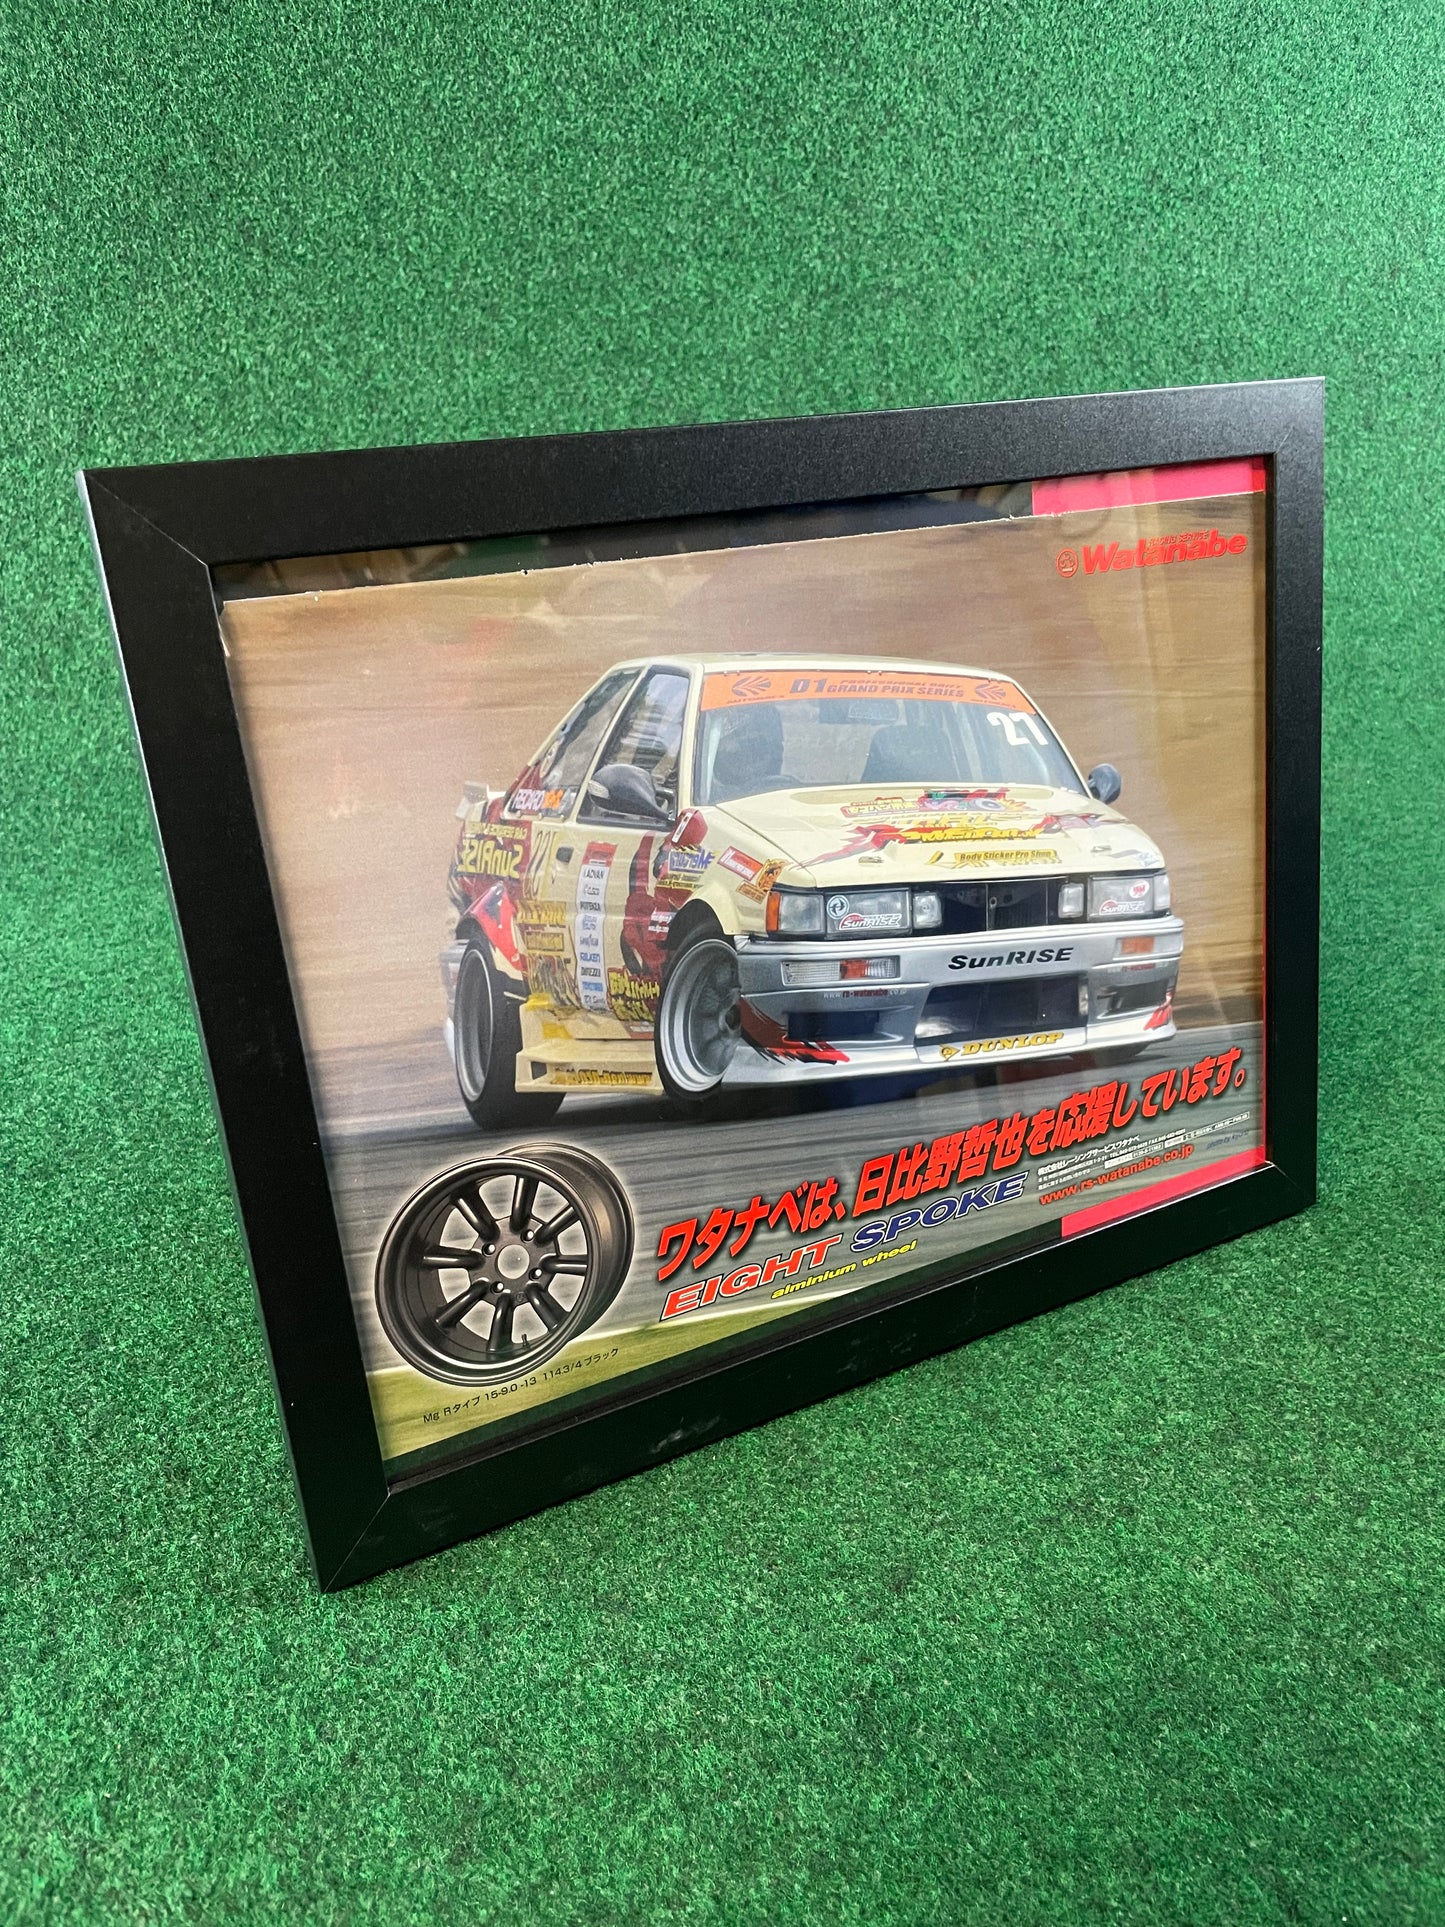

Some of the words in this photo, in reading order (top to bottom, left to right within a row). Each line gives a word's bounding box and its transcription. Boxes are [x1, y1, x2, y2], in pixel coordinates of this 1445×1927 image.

[1081, 528, 1248, 575] Watanabe
[790, 678, 828, 693] D1
[827, 684, 879, 694] GRAND
[881, 685, 915, 694] PRIX
[917, 686, 965, 698] SERIES
[987, 710, 1049, 746] 27
[960, 852, 983, 862] Body
[984, 851, 1015, 860] Sticker
[842, 917, 900, 928] SunRISE
[947, 946, 1075, 970] SunRISE
[960, 1031, 1064, 1057] DUNLOP
[657, 1046, 1247, 1282] ワタナベは、日比野哲也を応援しています。
[1039, 1143, 1194, 1206] www.rs-watanabe.co.jp
[660, 1232, 844, 1322] EIGHT
[850, 1170, 1029, 1253] SPOKE
[771, 1262, 857, 1300] alminium
[862, 1240, 918, 1268] wheel
[423, 1412, 440, 1424] Mg
[543, 1360, 582, 1382] 114.3/4
[584, 1347, 619, 1367] ブラック
